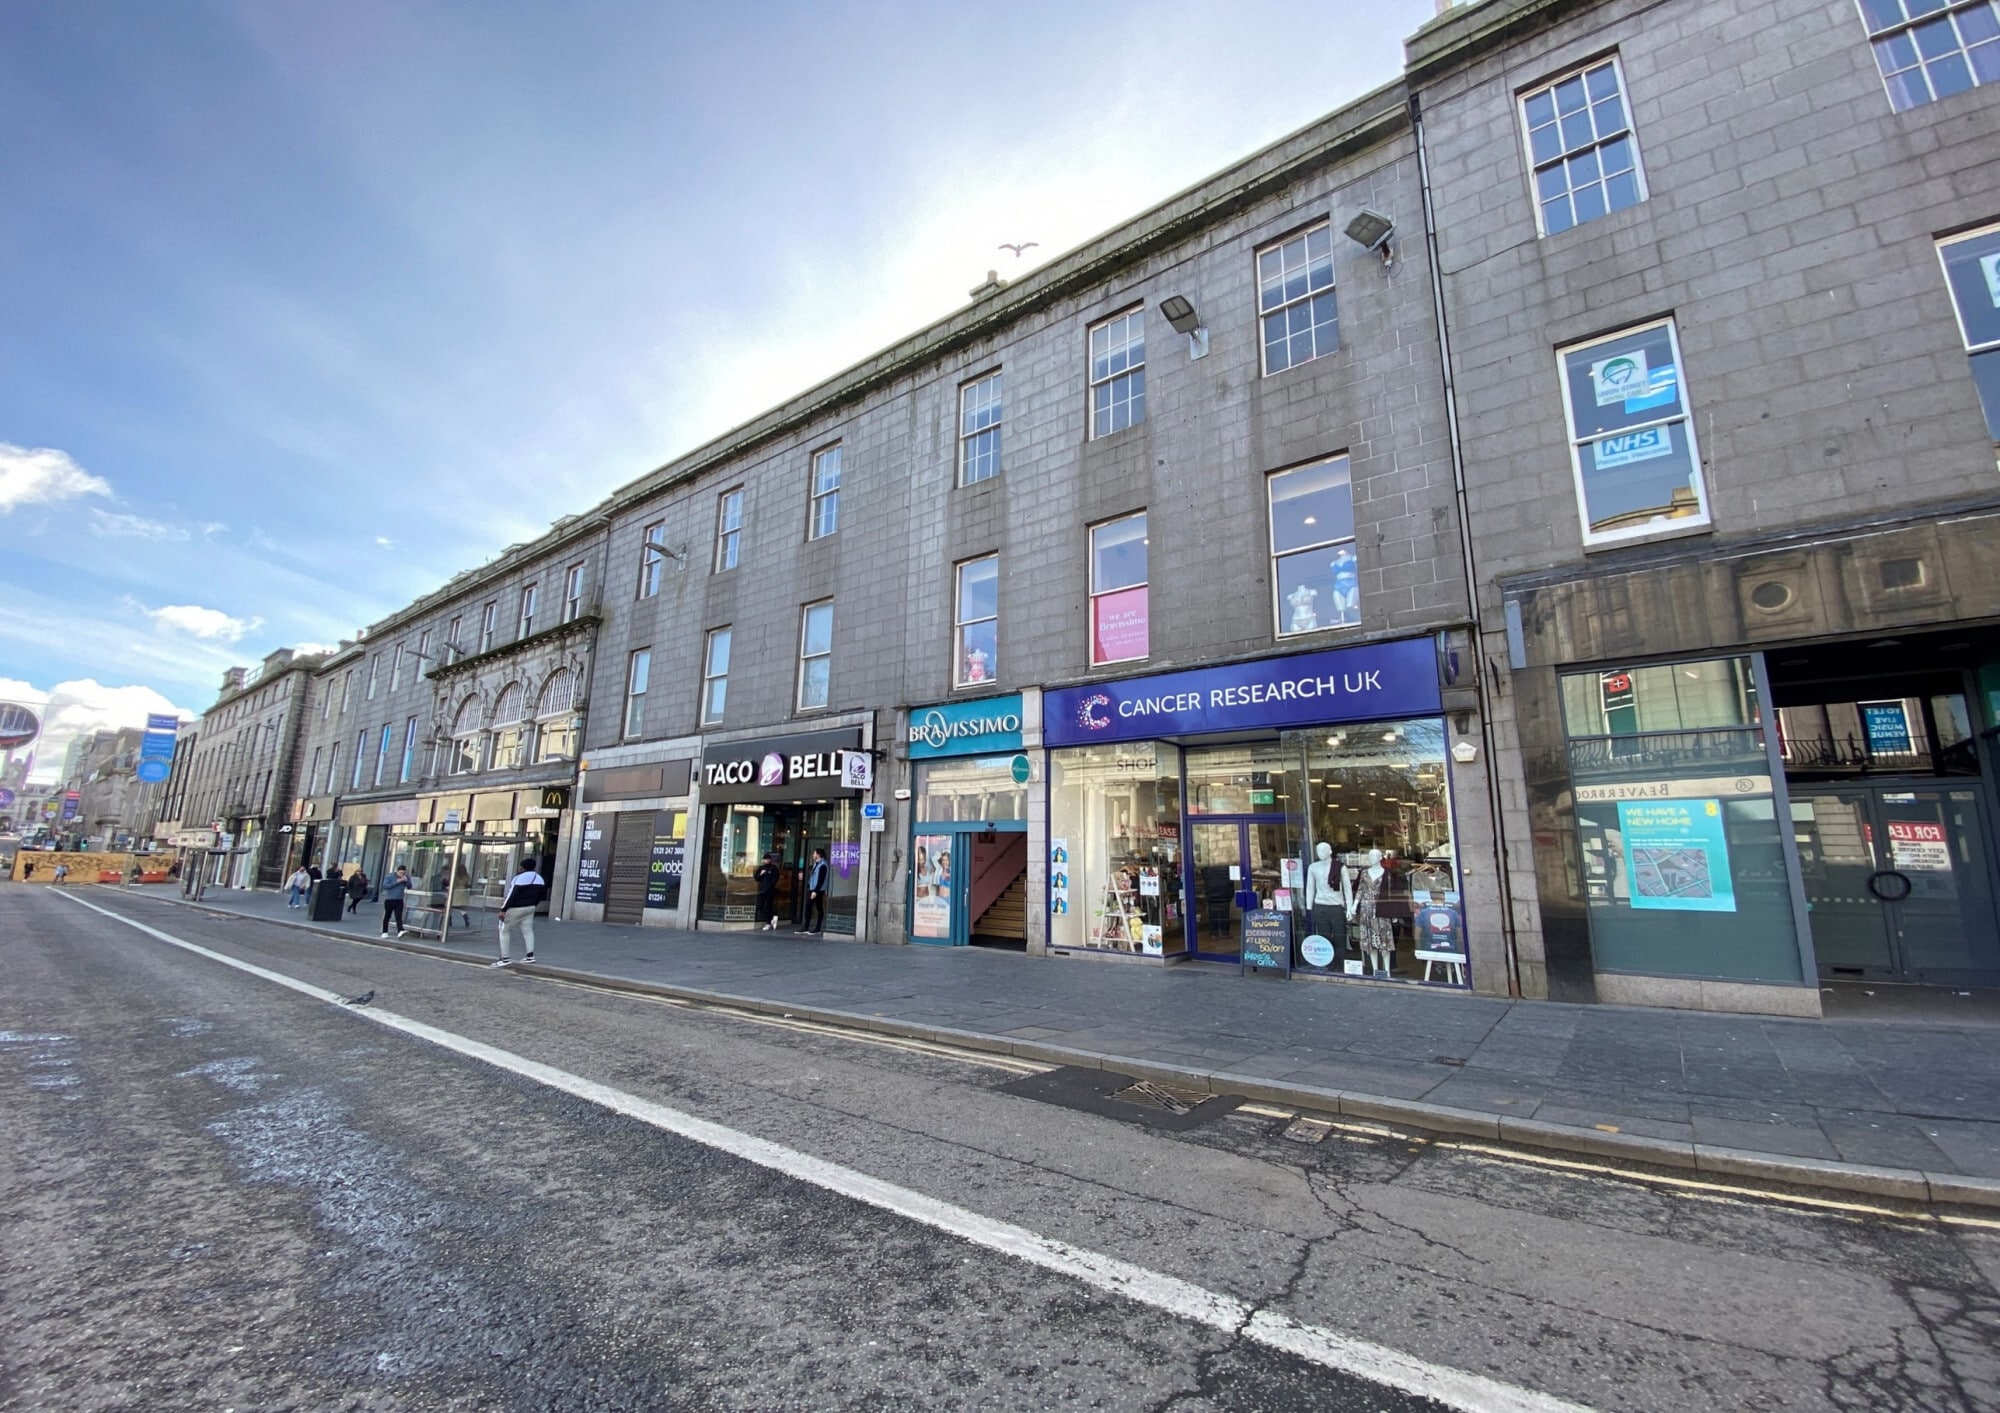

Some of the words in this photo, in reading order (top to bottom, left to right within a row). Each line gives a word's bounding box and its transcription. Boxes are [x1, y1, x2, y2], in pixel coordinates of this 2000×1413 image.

[1604, 429, 1656, 455] NHS
[1100, 617, 1146, 631] Bravissimo
[1118, 692, 1201, 718] CANCER
[1210, 676, 1335, 708] RESEARCH
[1344, 670, 1382, 693] UK
[909, 710, 1020, 748] BRAVISSIMO
[705, 760, 753, 785] TACO
[789, 751, 841, 779] BELL
[1626, 808, 1643, 816] WE
[1646, 807, 1676, 816] HAVE
[1679, 807, 1688, 815] A
[1627, 817, 1654, 826] NEW
[1656, 816, 1692, 826] HOME
[580, 868, 589, 877] FOR
[589, 868, 600, 878] SALE
